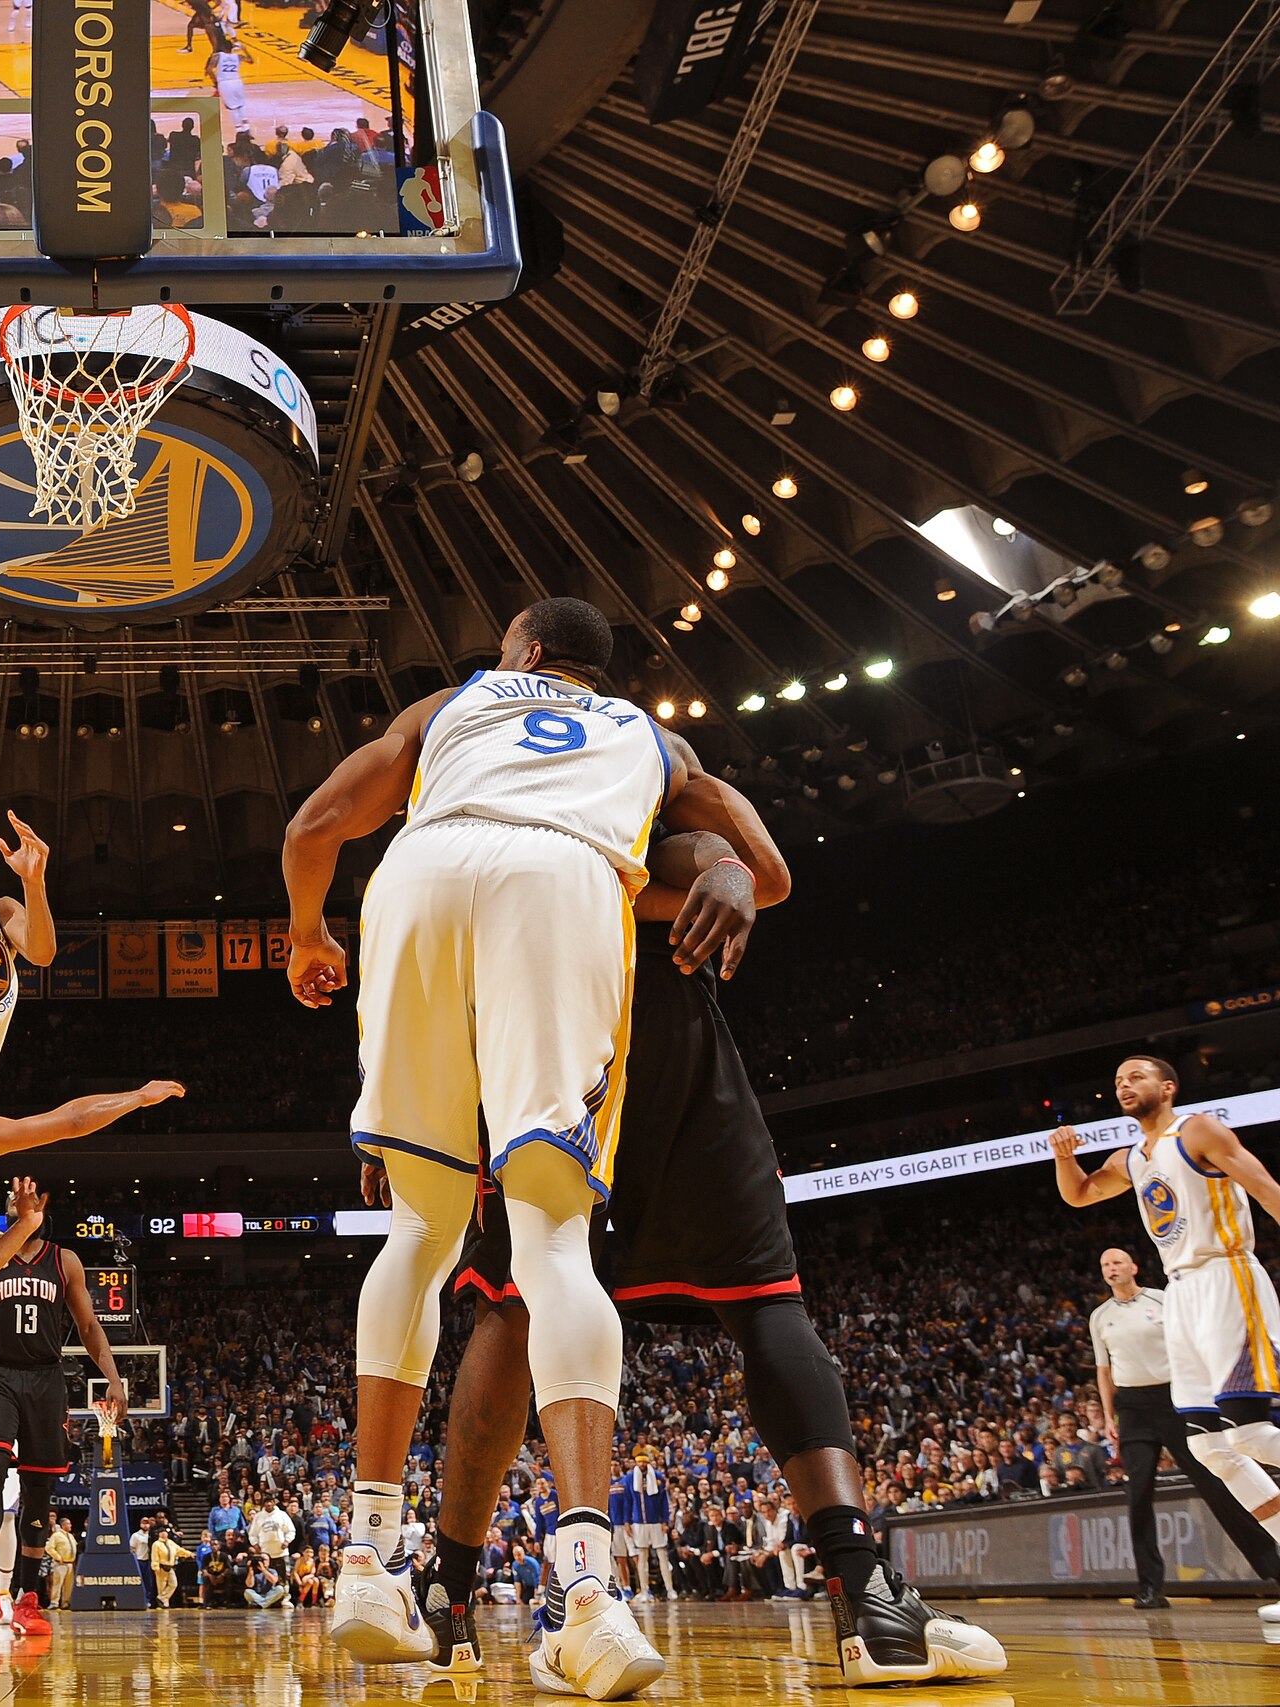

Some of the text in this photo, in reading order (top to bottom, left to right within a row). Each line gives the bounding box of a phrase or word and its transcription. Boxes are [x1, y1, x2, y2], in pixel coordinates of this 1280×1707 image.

[676, 2, 741, 75] JBL
[479, 678, 639, 728] IGUOALA
[513, 710, 587, 755] 9
[229, 938, 253, 964] 17
[171, 968, 213, 976] 2014-2015
[813, 1126, 1120, 1191] THE BAY'S GIGABIT FIBER INRNET
[86, 1215, 104, 1223] 4th
[150, 1218, 175, 1234] 92
[244, 1221, 262, 1230] TOL
[290, 1221, 301, 1229] TF
[301, 1220, 311, 1230] 0
[76, 1223, 114, 1238] 3:01
[98, 1272, 128, 1286] 3:01
[108, 1287, 124, 1311] 6
[14, 1304, 38, 1334] 13
[97, 1314, 131, 1322] TISSOT
[49, 1495, 71, 1506] CITY
[129, 1496, 160, 1506] BANK
[1081, 1510, 1194, 1571] NBA PP
[916, 1528, 990, 1576] NBA APP
[84, 1576, 141, 1586] NBA LEAGUE PASS
[457, 1650, 471, 1662] 23
[844, 1645, 861, 1662] 23
